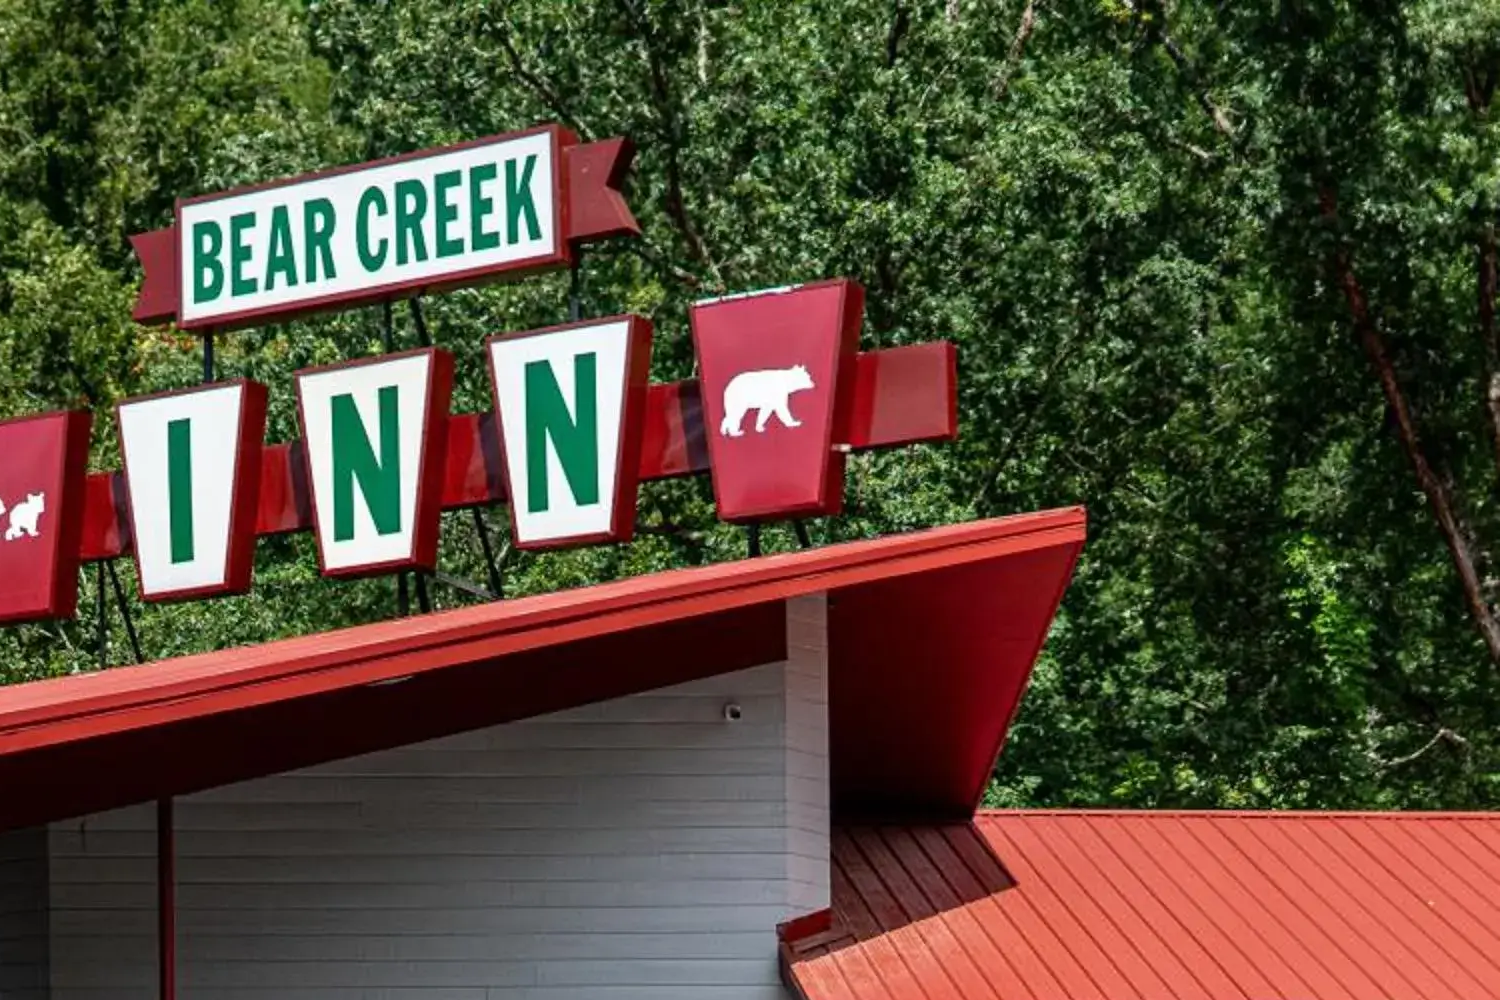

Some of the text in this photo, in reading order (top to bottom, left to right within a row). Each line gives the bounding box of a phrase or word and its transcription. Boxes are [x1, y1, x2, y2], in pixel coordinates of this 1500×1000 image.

[192, 153, 543, 305] BEAR CREEK
[167, 350, 599, 564] INN
